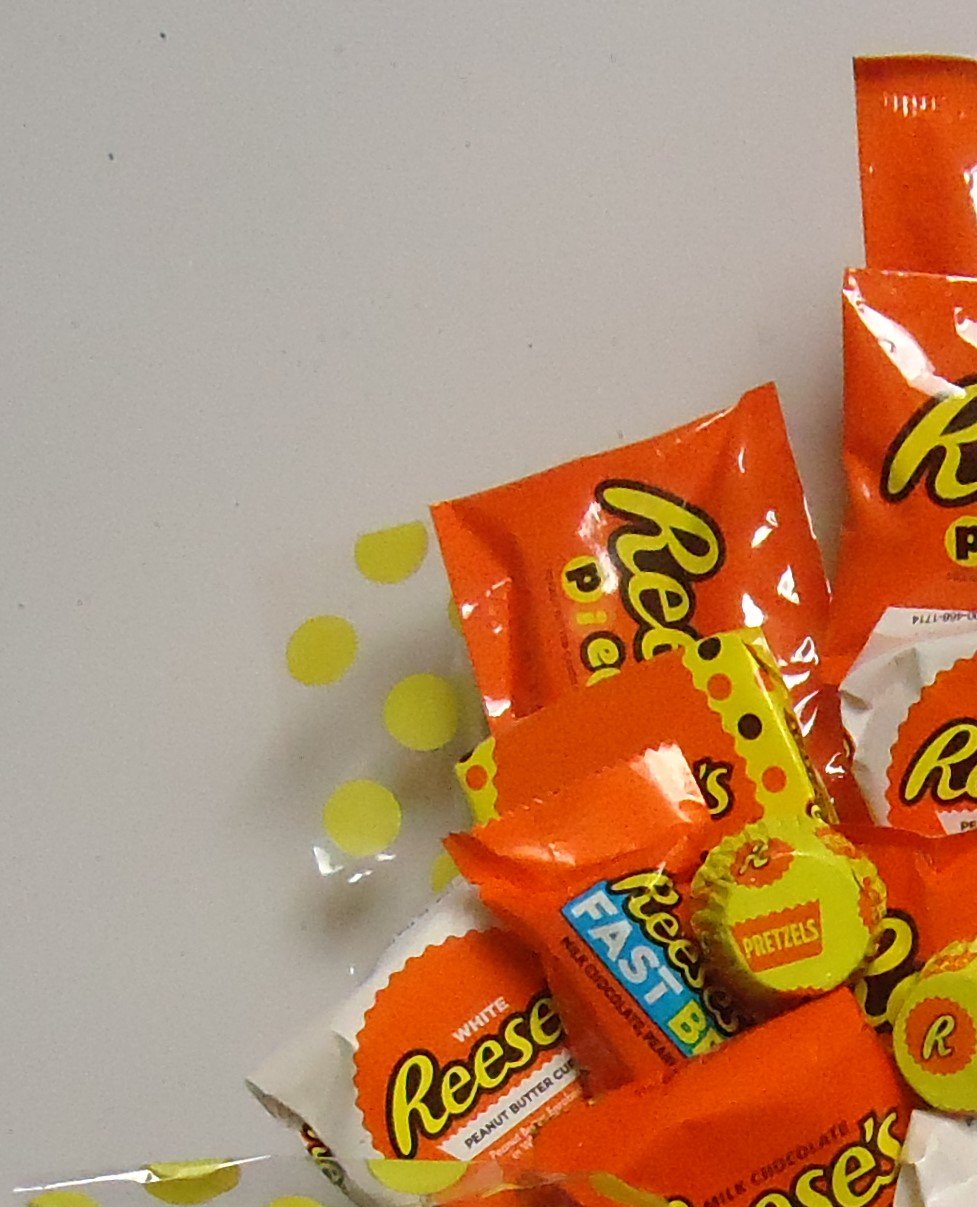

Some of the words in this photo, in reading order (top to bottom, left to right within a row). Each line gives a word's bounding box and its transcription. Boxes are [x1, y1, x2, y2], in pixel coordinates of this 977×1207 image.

[570, 889, 685, 1007] FAST
[742, 917, 820, 960] PRETZELS
[452, 996, 511, 1043] WHITE
[920, 1013, 957, 1061] R
[386, 988, 567, 1158] Reese
[464, 1111, 511, 1150] PEANUT
[509, 1077, 554, 1115] BUTTER
[750, 1119, 850, 1186] CHOCOLATE
